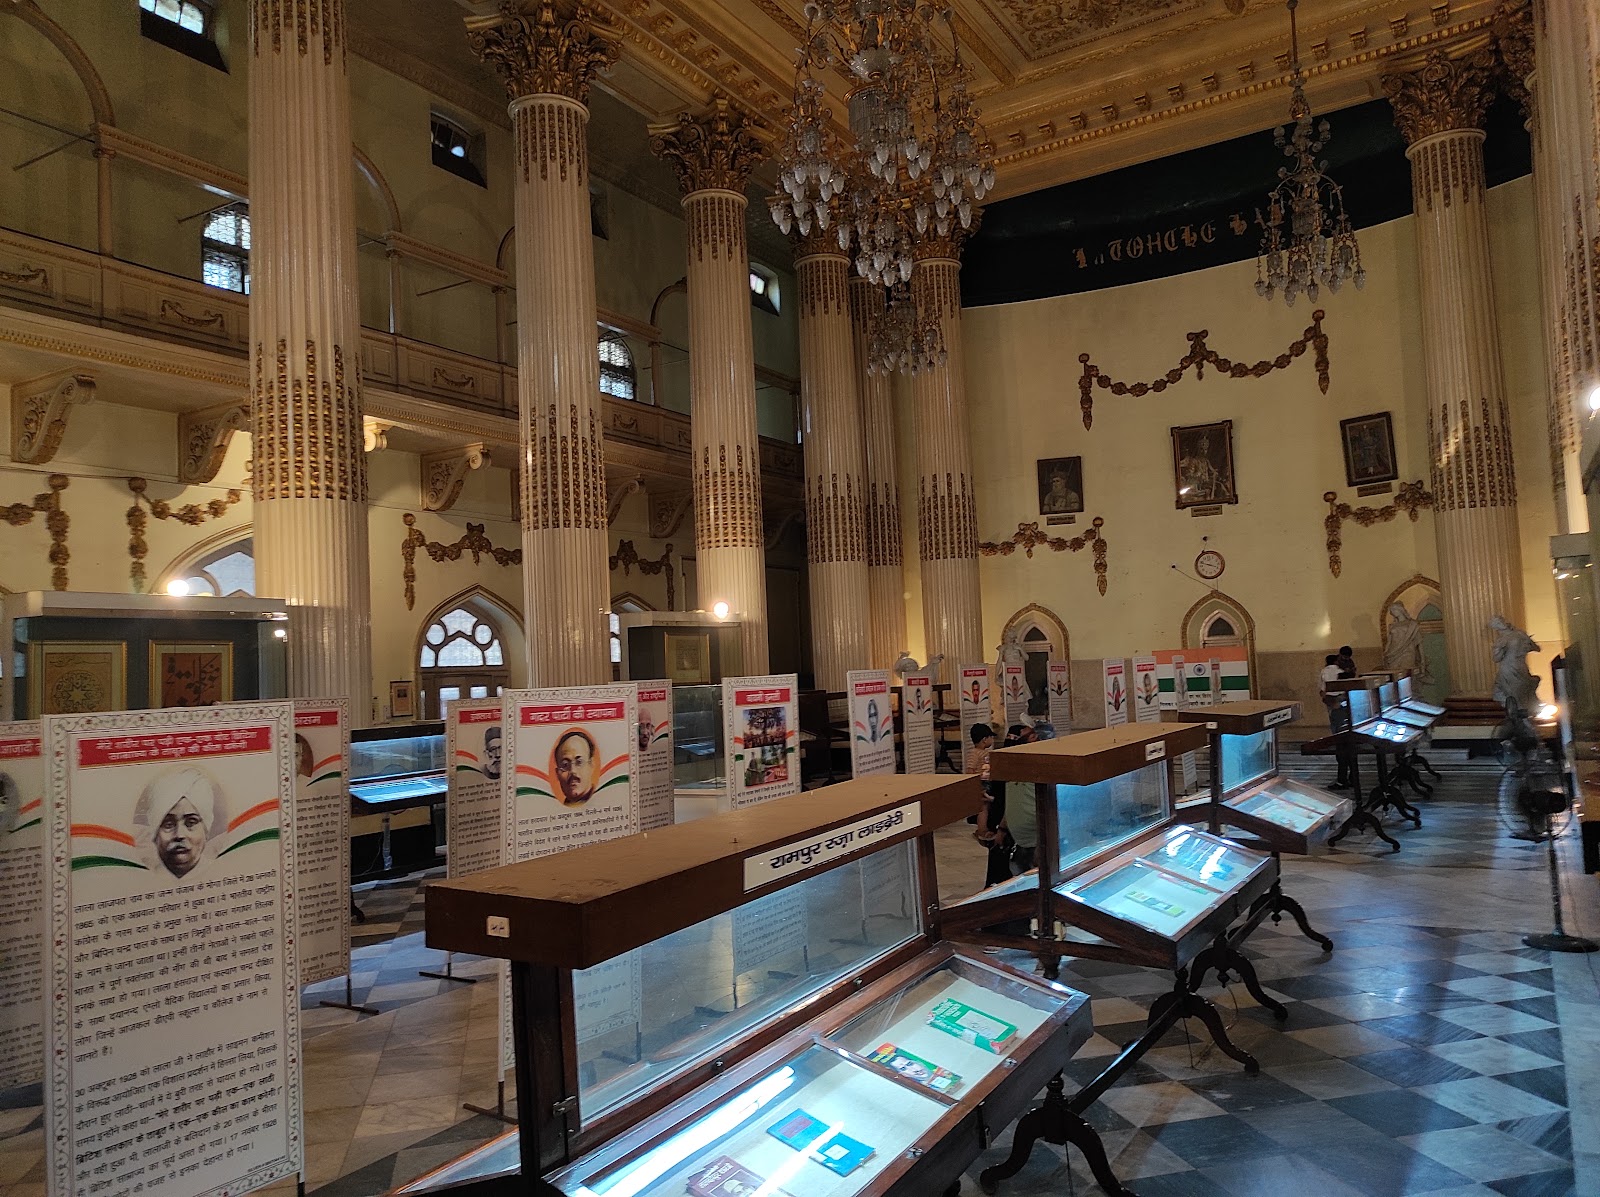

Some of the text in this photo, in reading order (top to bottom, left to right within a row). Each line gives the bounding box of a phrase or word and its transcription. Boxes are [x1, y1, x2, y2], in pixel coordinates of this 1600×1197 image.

[551, 706, 571, 720] पार्टी
[572, 706, 584, 719] की
[586, 707, 616, 718] स्थापना
[770, 811, 904, 869] रामपुर रज़ा लाइब्रेरी
